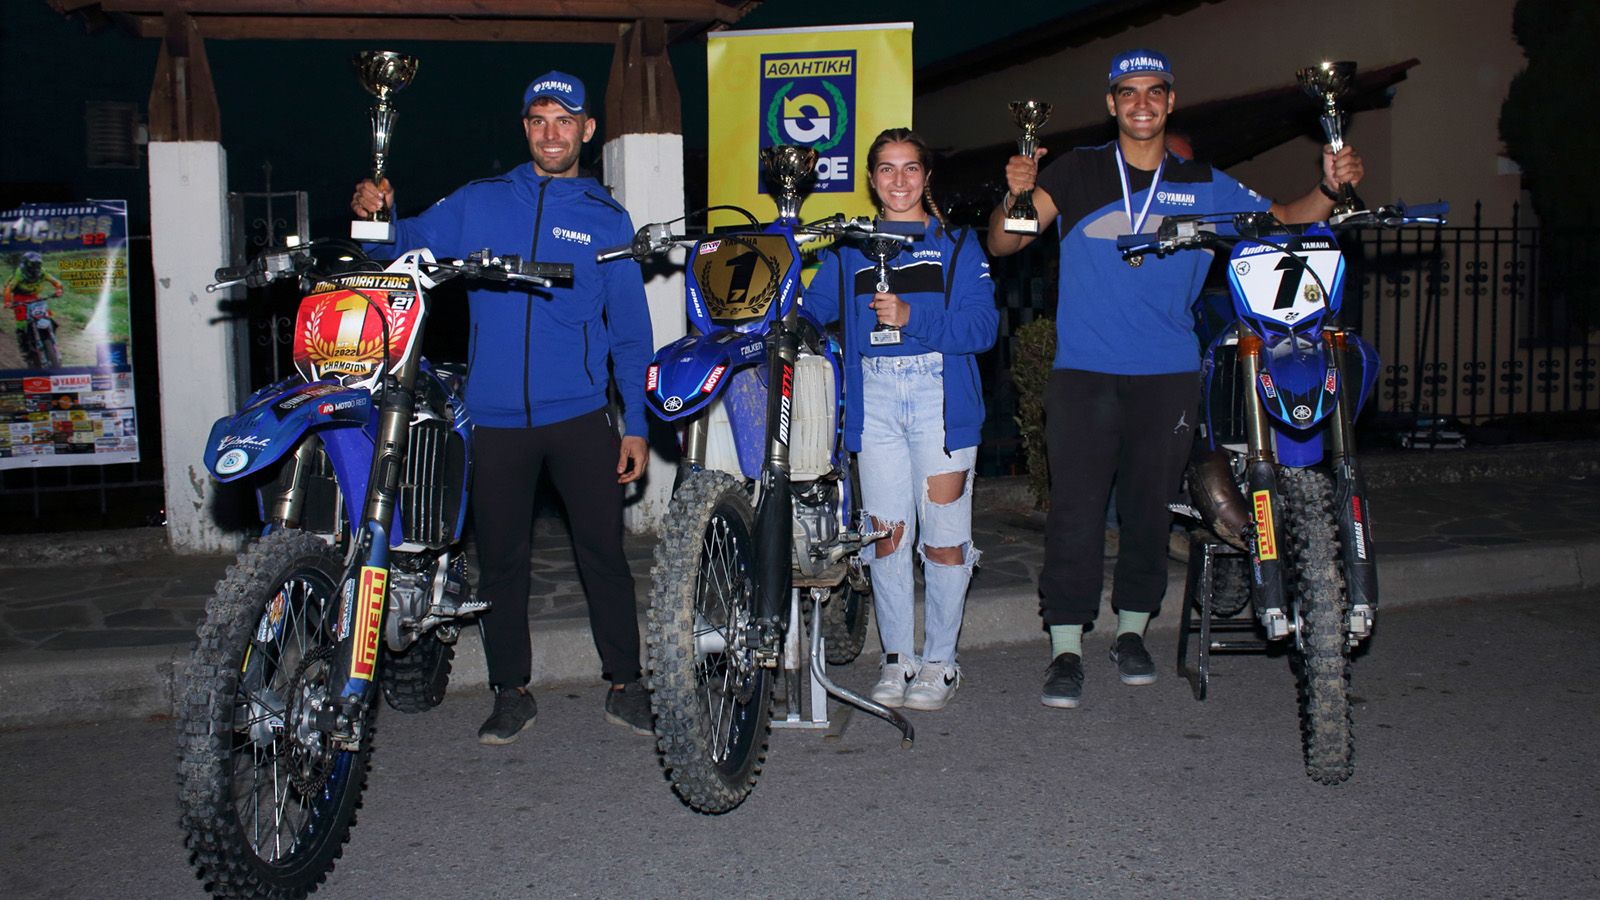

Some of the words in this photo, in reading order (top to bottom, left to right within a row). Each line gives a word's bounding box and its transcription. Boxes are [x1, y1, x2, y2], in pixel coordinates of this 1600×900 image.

[767, 60, 850, 76] ΑΘΛΗΤΙΚΗ
[1130, 57, 1163, 69] YAMAHA
[541, 81, 572, 92] YAMAHA
[1167, 192, 1195, 204] YAMAHA
[562, 229, 591, 243] YAMAHA
[726, 250, 760, 304] 1
[1273, 255, 1309, 310] 1
[391, 297, 414, 310] 21
[334, 293, 370, 356] 1
[334, 349, 357, 357] 2022
[323, 361, 367, 373] CHAMPION
[59, 376, 91, 385] YAMAHA
[647, 365, 659, 390] MOTUL
[705, 365, 726, 392] MOTUL
[1255, 494, 1274, 555] PIRELLI
[354, 568, 386, 676] PIRELLI
